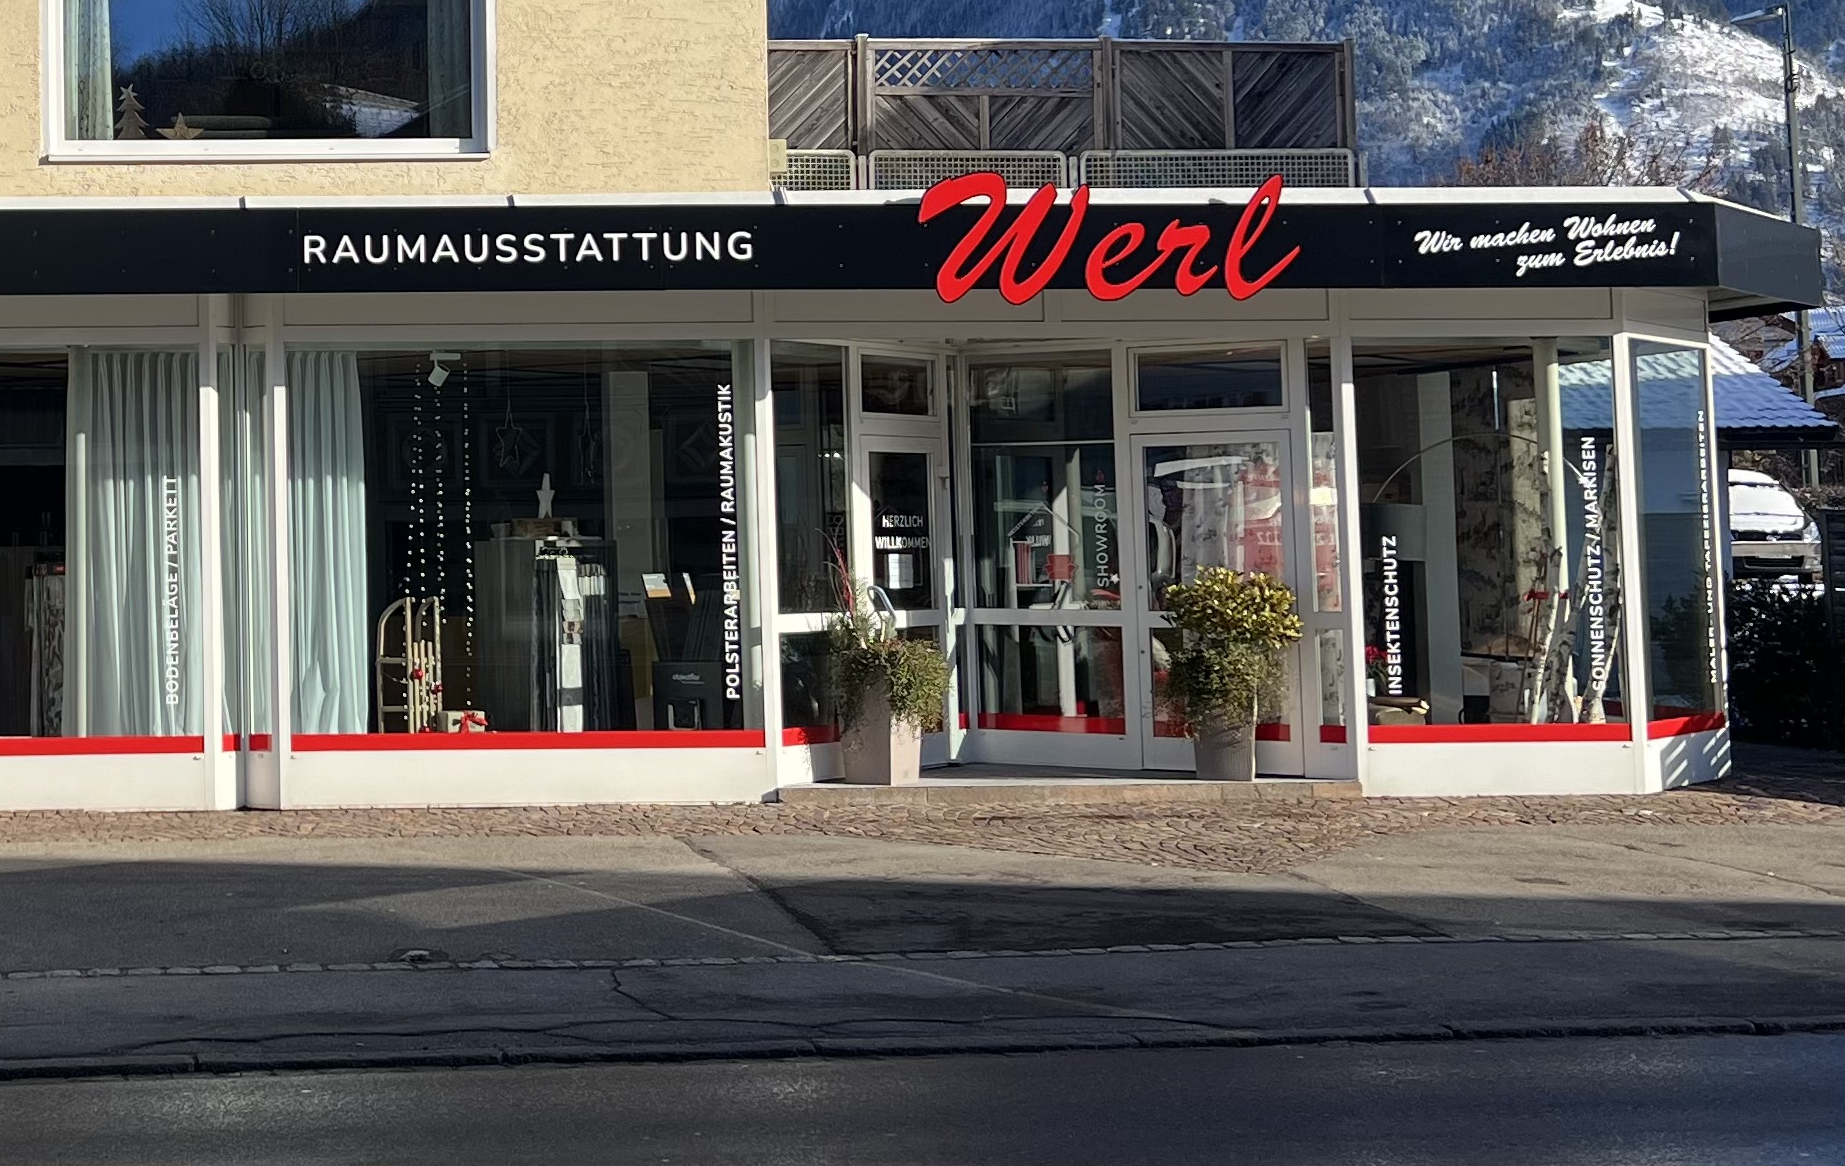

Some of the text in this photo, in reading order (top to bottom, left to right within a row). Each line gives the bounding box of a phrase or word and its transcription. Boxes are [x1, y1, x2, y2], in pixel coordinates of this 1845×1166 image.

[303, 230, 754, 264] RAUMAUSSTATTUNG
[918, 170, 1301, 305] Werl
[1414, 213, 1656, 254] Wir machen Wohnen
[1516, 231, 1680, 277] zum Erlebnis!
[717, 383, 736, 513] RAUMAKUSTIK
[1581, 436, 1598, 529] MARKISEN
[164, 475, 179, 555] PARKETT
[875, 535, 930, 549] WILLKOMMEN
[882, 515, 923, 528] HERZLICH
[1094, 484, 1110, 587] SHOWROOM
[163, 572, 179, 706] BODENBELÄGE
[722, 530, 741, 700] POLSTERARBEITEN
[1381, 535, 1403, 695] INSEKTENSCHUTZ
[1587, 543, 1605, 692] SONNENSCHUTZ
